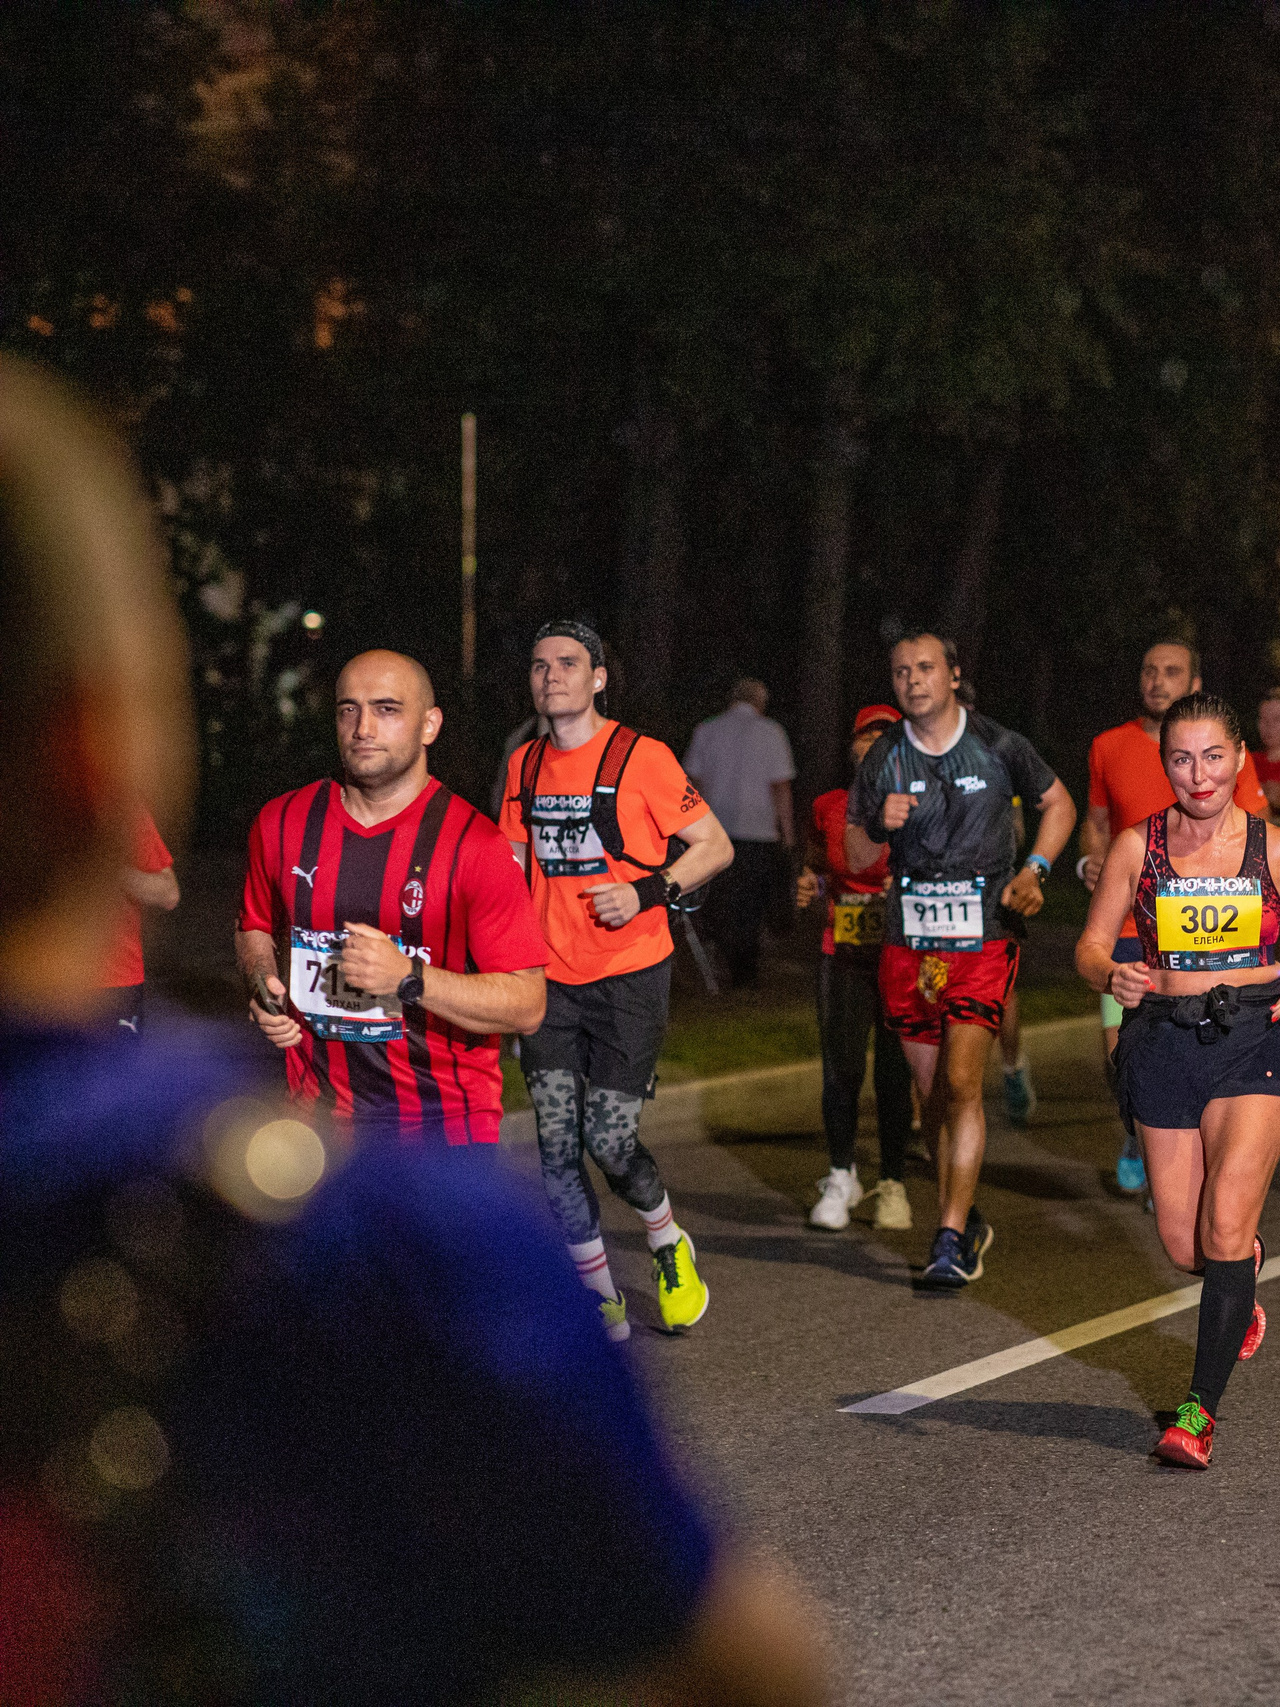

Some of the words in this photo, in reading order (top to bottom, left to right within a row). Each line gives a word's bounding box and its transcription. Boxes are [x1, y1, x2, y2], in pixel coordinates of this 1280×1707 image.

[540, 822, 589, 844] 449
[1167, 876, 1253, 892] НОЧНОЙ
[914, 903, 967, 922] 9111
[1181, 905, 1238, 933] 302
[1194, 935, 1225, 945] ЕЛЕНА
[326, 999, 361, 1010] ЭЛХАН
